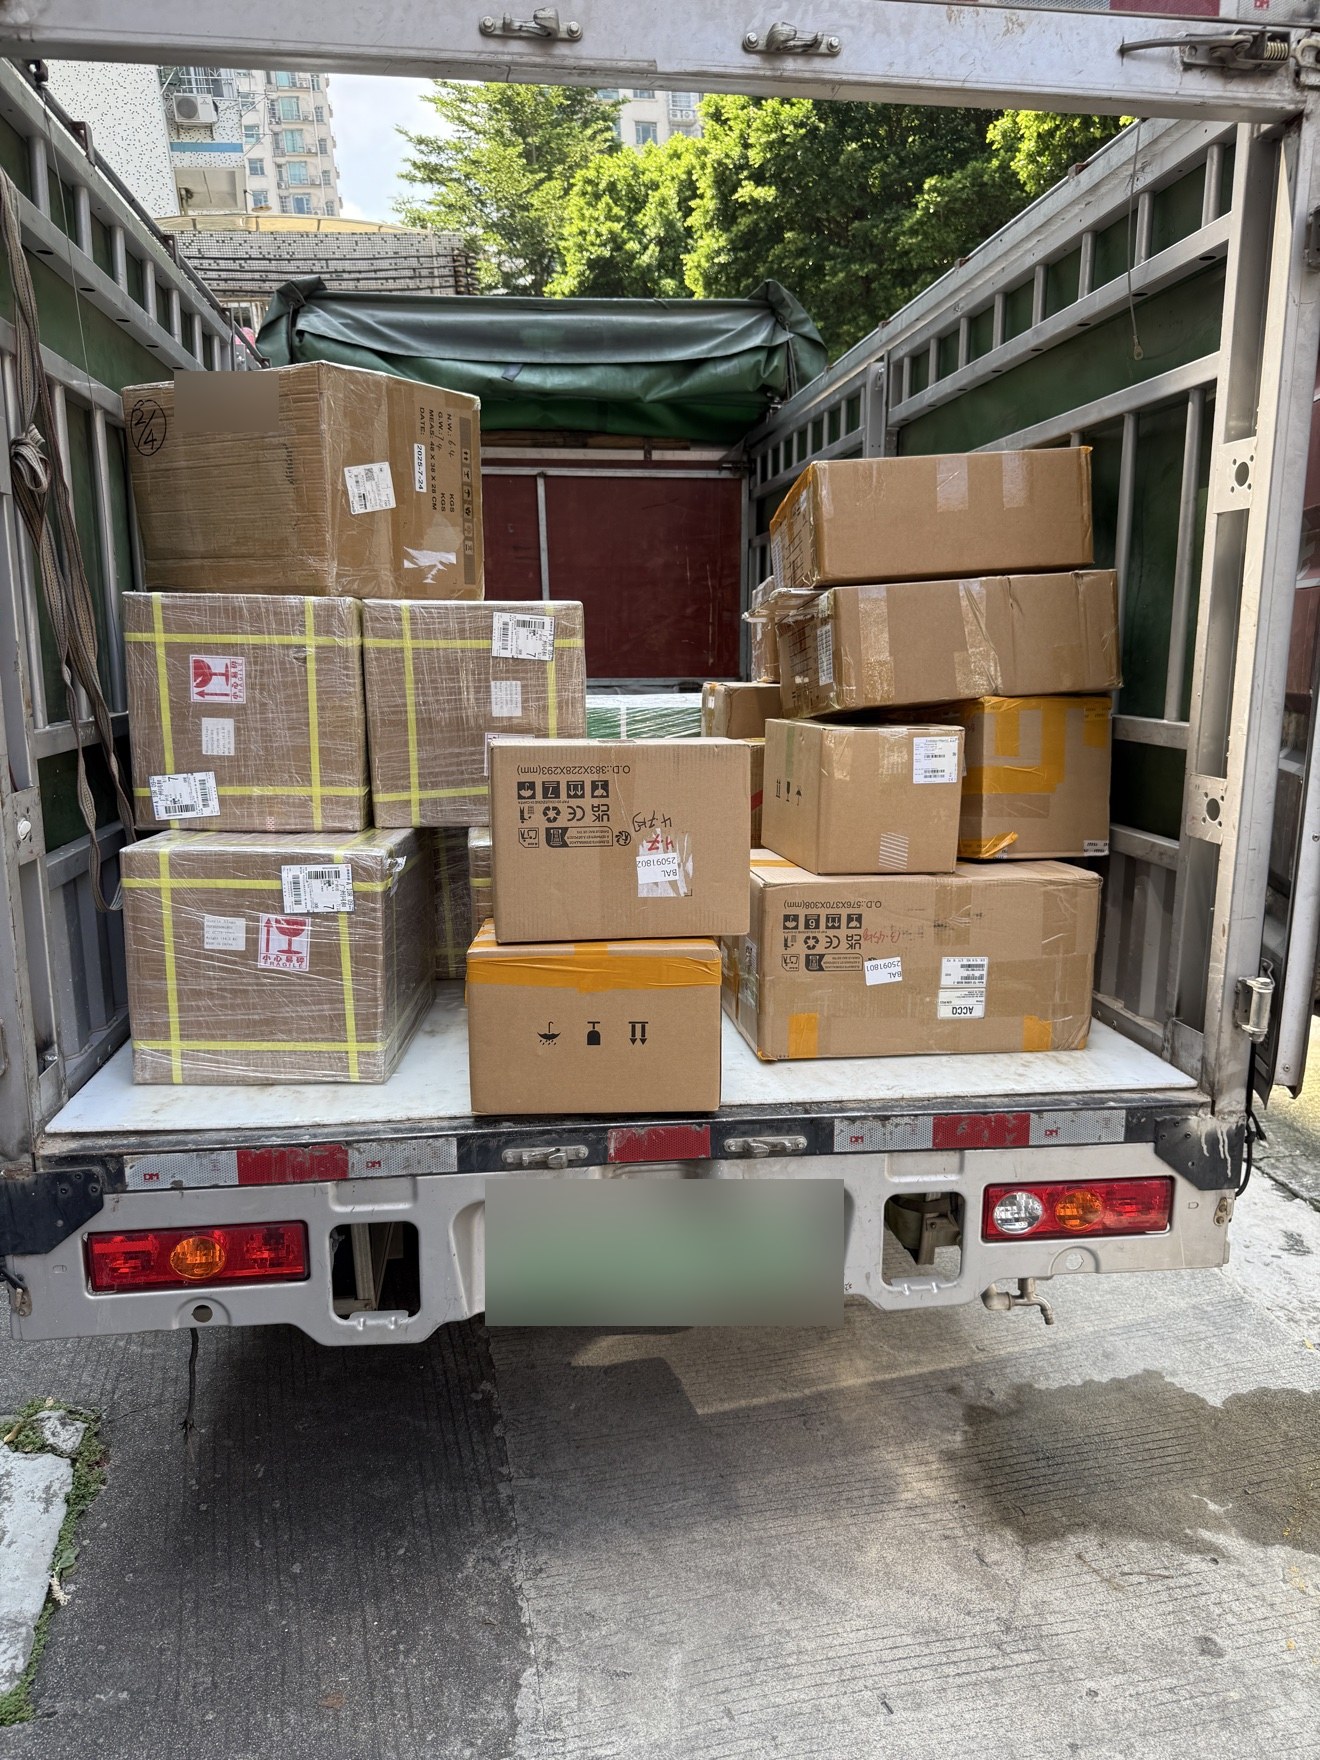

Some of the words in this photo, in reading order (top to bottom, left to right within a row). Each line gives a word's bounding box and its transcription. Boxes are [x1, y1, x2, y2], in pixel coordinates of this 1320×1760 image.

[134, 408, 158, 450] 2/4
[416, 445, 425, 491] 2025-7-24
[432, 497, 437, 511] CM
[516, 765, 631, 775] O.D.:383X228X293(mm)
[566, 805, 585, 822] CE
[592, 813, 610, 822] UK
[646, 834, 674, 851] 4.7
[637, 856, 676, 868] 25091802
[660, 868, 678, 878] BAL
[783, 900, 882, 909] O.D.:576X370X308(mm)
[824, 935, 841, 949] CE
[846, 942, 862, 950] UK
[264, 960, 303, 968] FRAGILE
[866, 960, 901, 972] 25091801
[887, 970, 902, 979] BAL
[143, 1172, 159, 1181] DM
